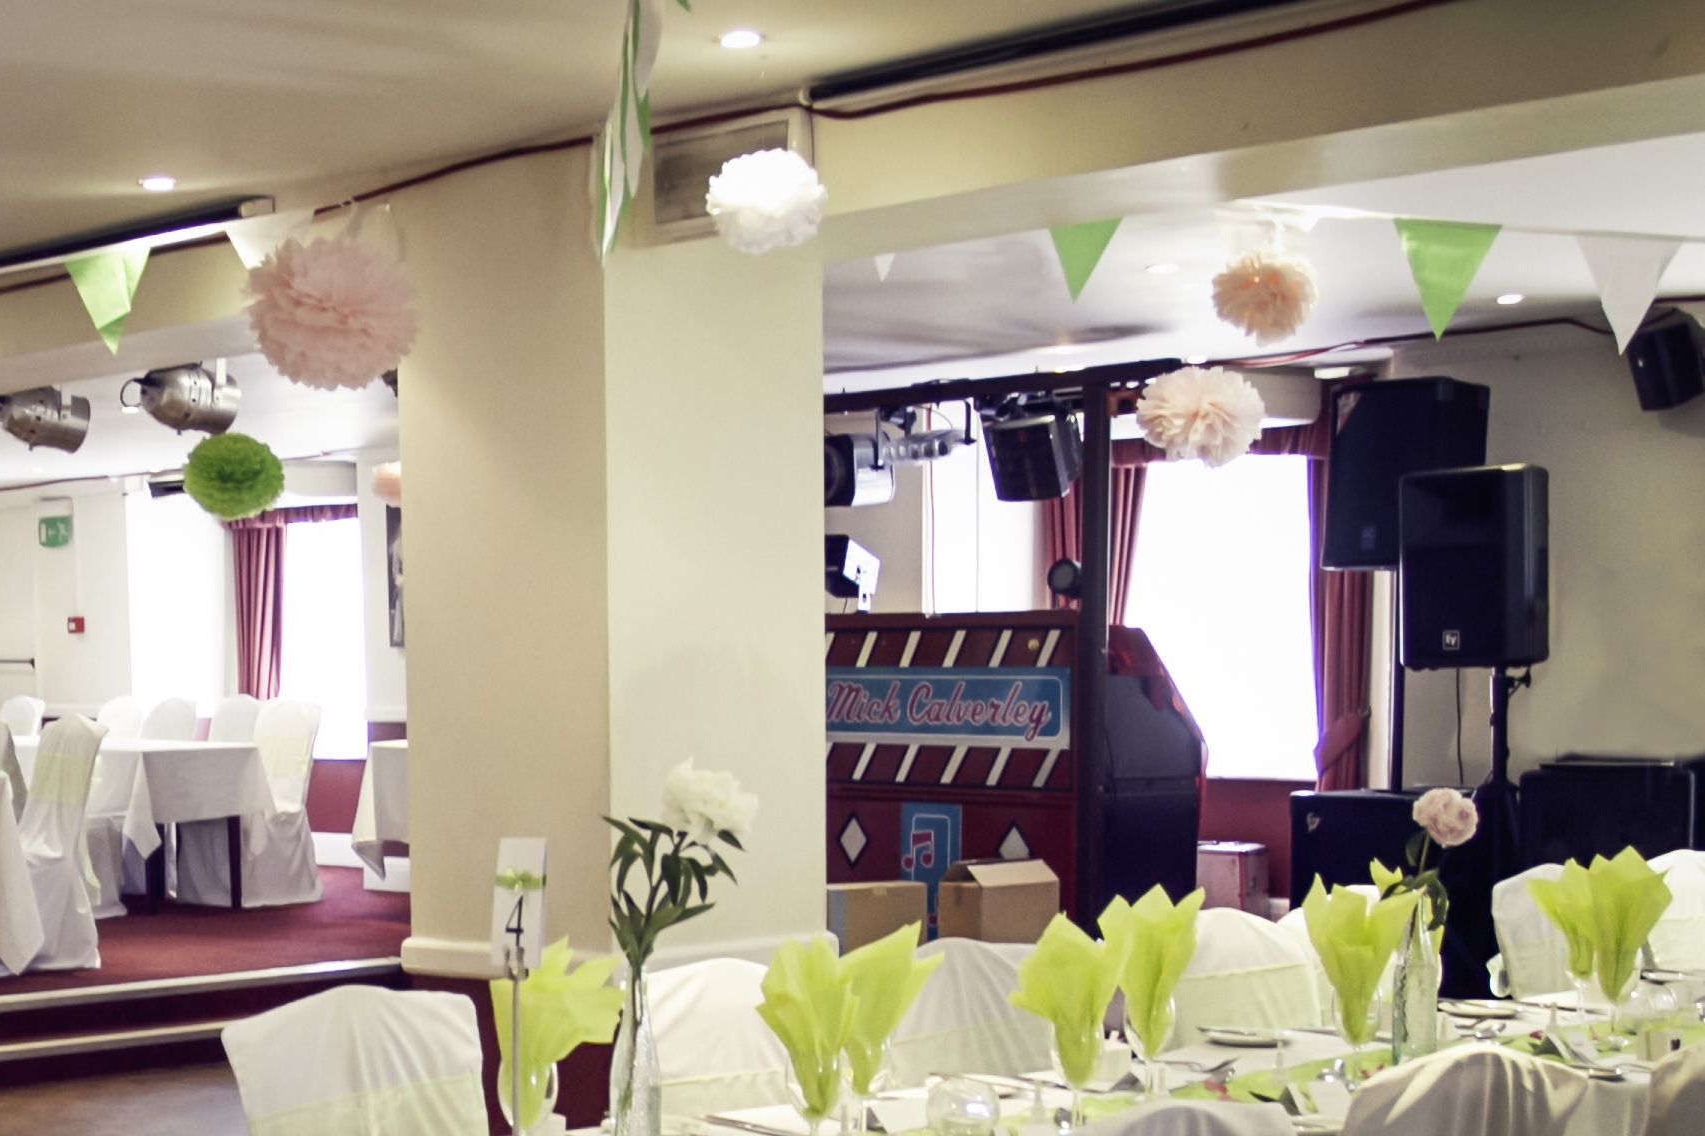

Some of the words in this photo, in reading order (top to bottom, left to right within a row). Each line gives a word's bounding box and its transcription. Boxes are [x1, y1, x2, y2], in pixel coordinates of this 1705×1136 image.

[827, 680, 901, 723] Mick
[908, 681, 1052, 741] Calverley
[505, 895, 524, 947] 4
